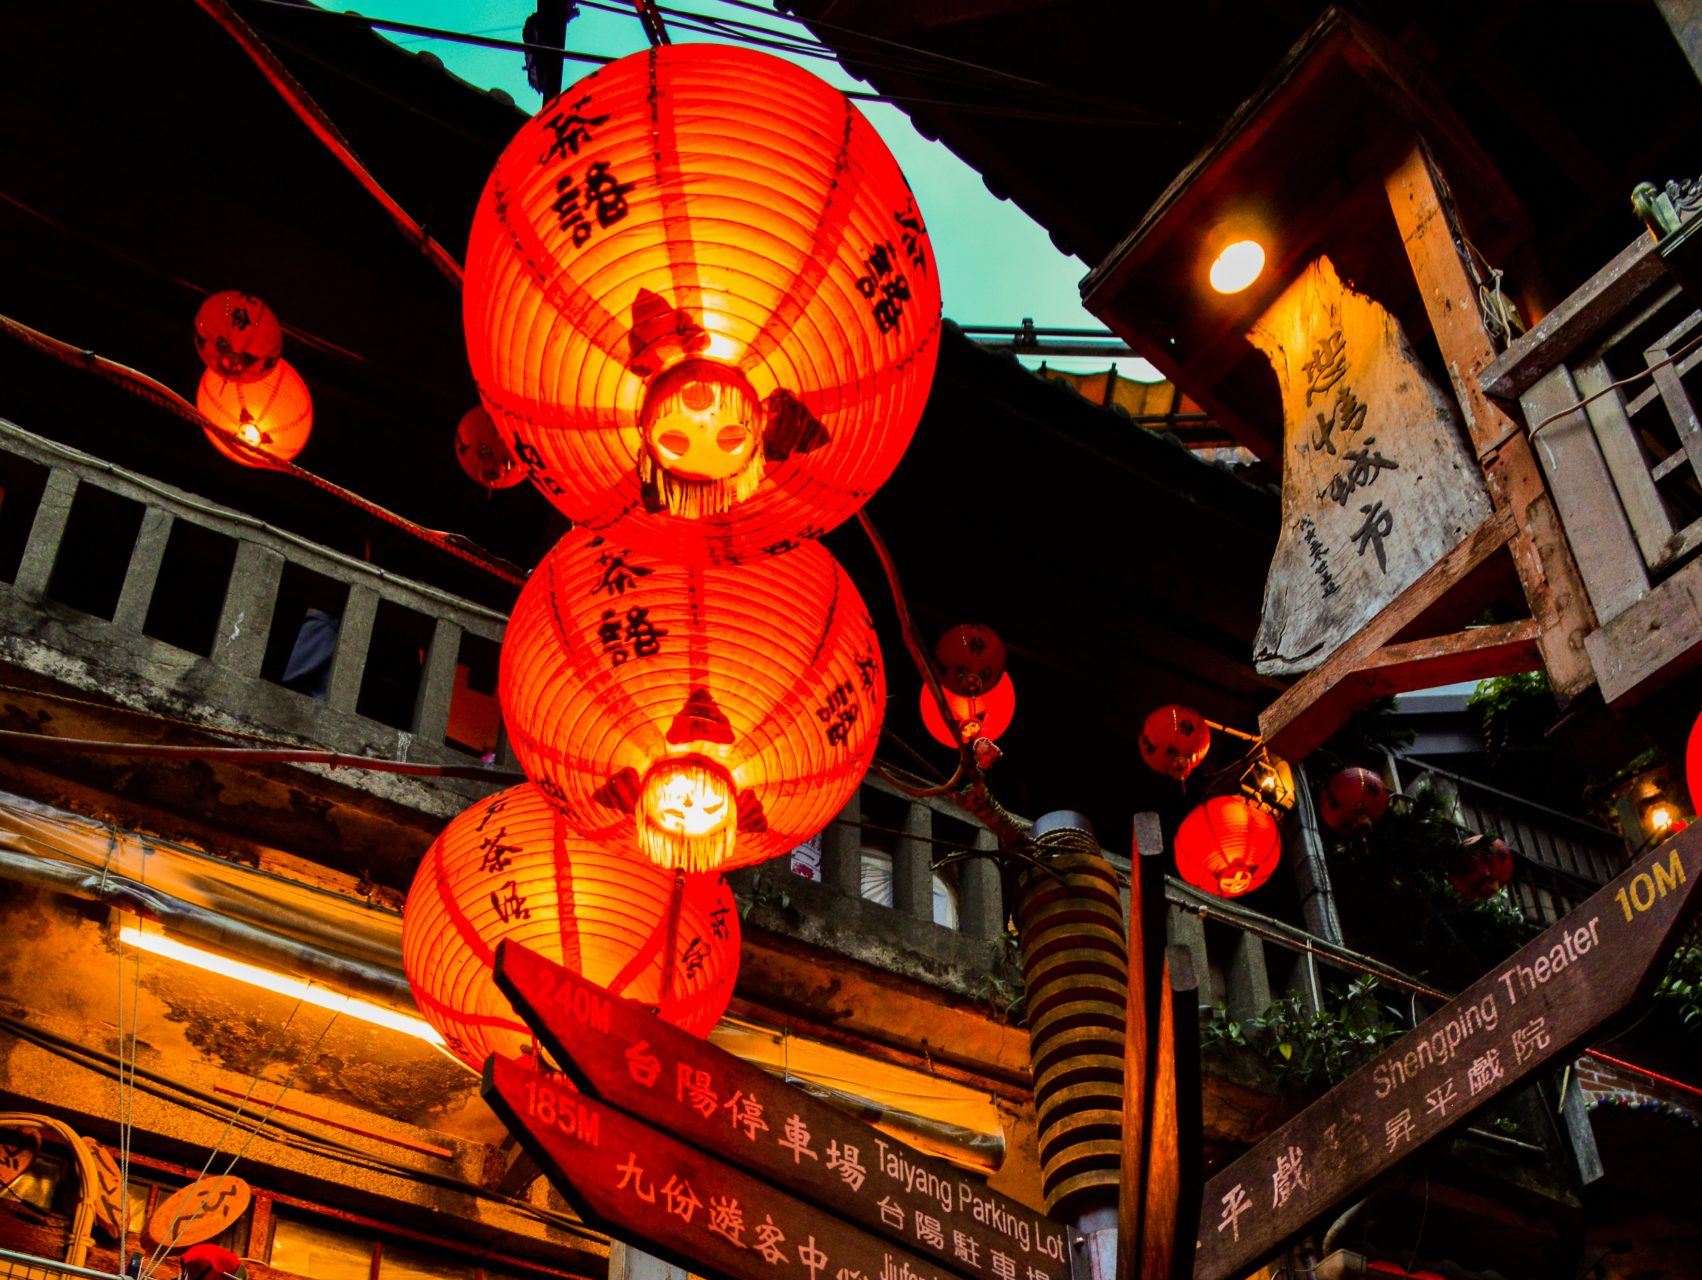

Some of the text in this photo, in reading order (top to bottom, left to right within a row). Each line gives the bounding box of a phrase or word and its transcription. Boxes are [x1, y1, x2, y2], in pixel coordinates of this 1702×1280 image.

[1614, 848, 1687, 923] 10M
[540, 971, 611, 1035] 240M
[1372, 916, 1601, 1101] Shengping Theater
[525, 1081, 599, 1147] 185M
[625, 1040, 867, 1192] 台陽停車場
[874, 1138, 1065, 1263] Taiyang Parking Lot
